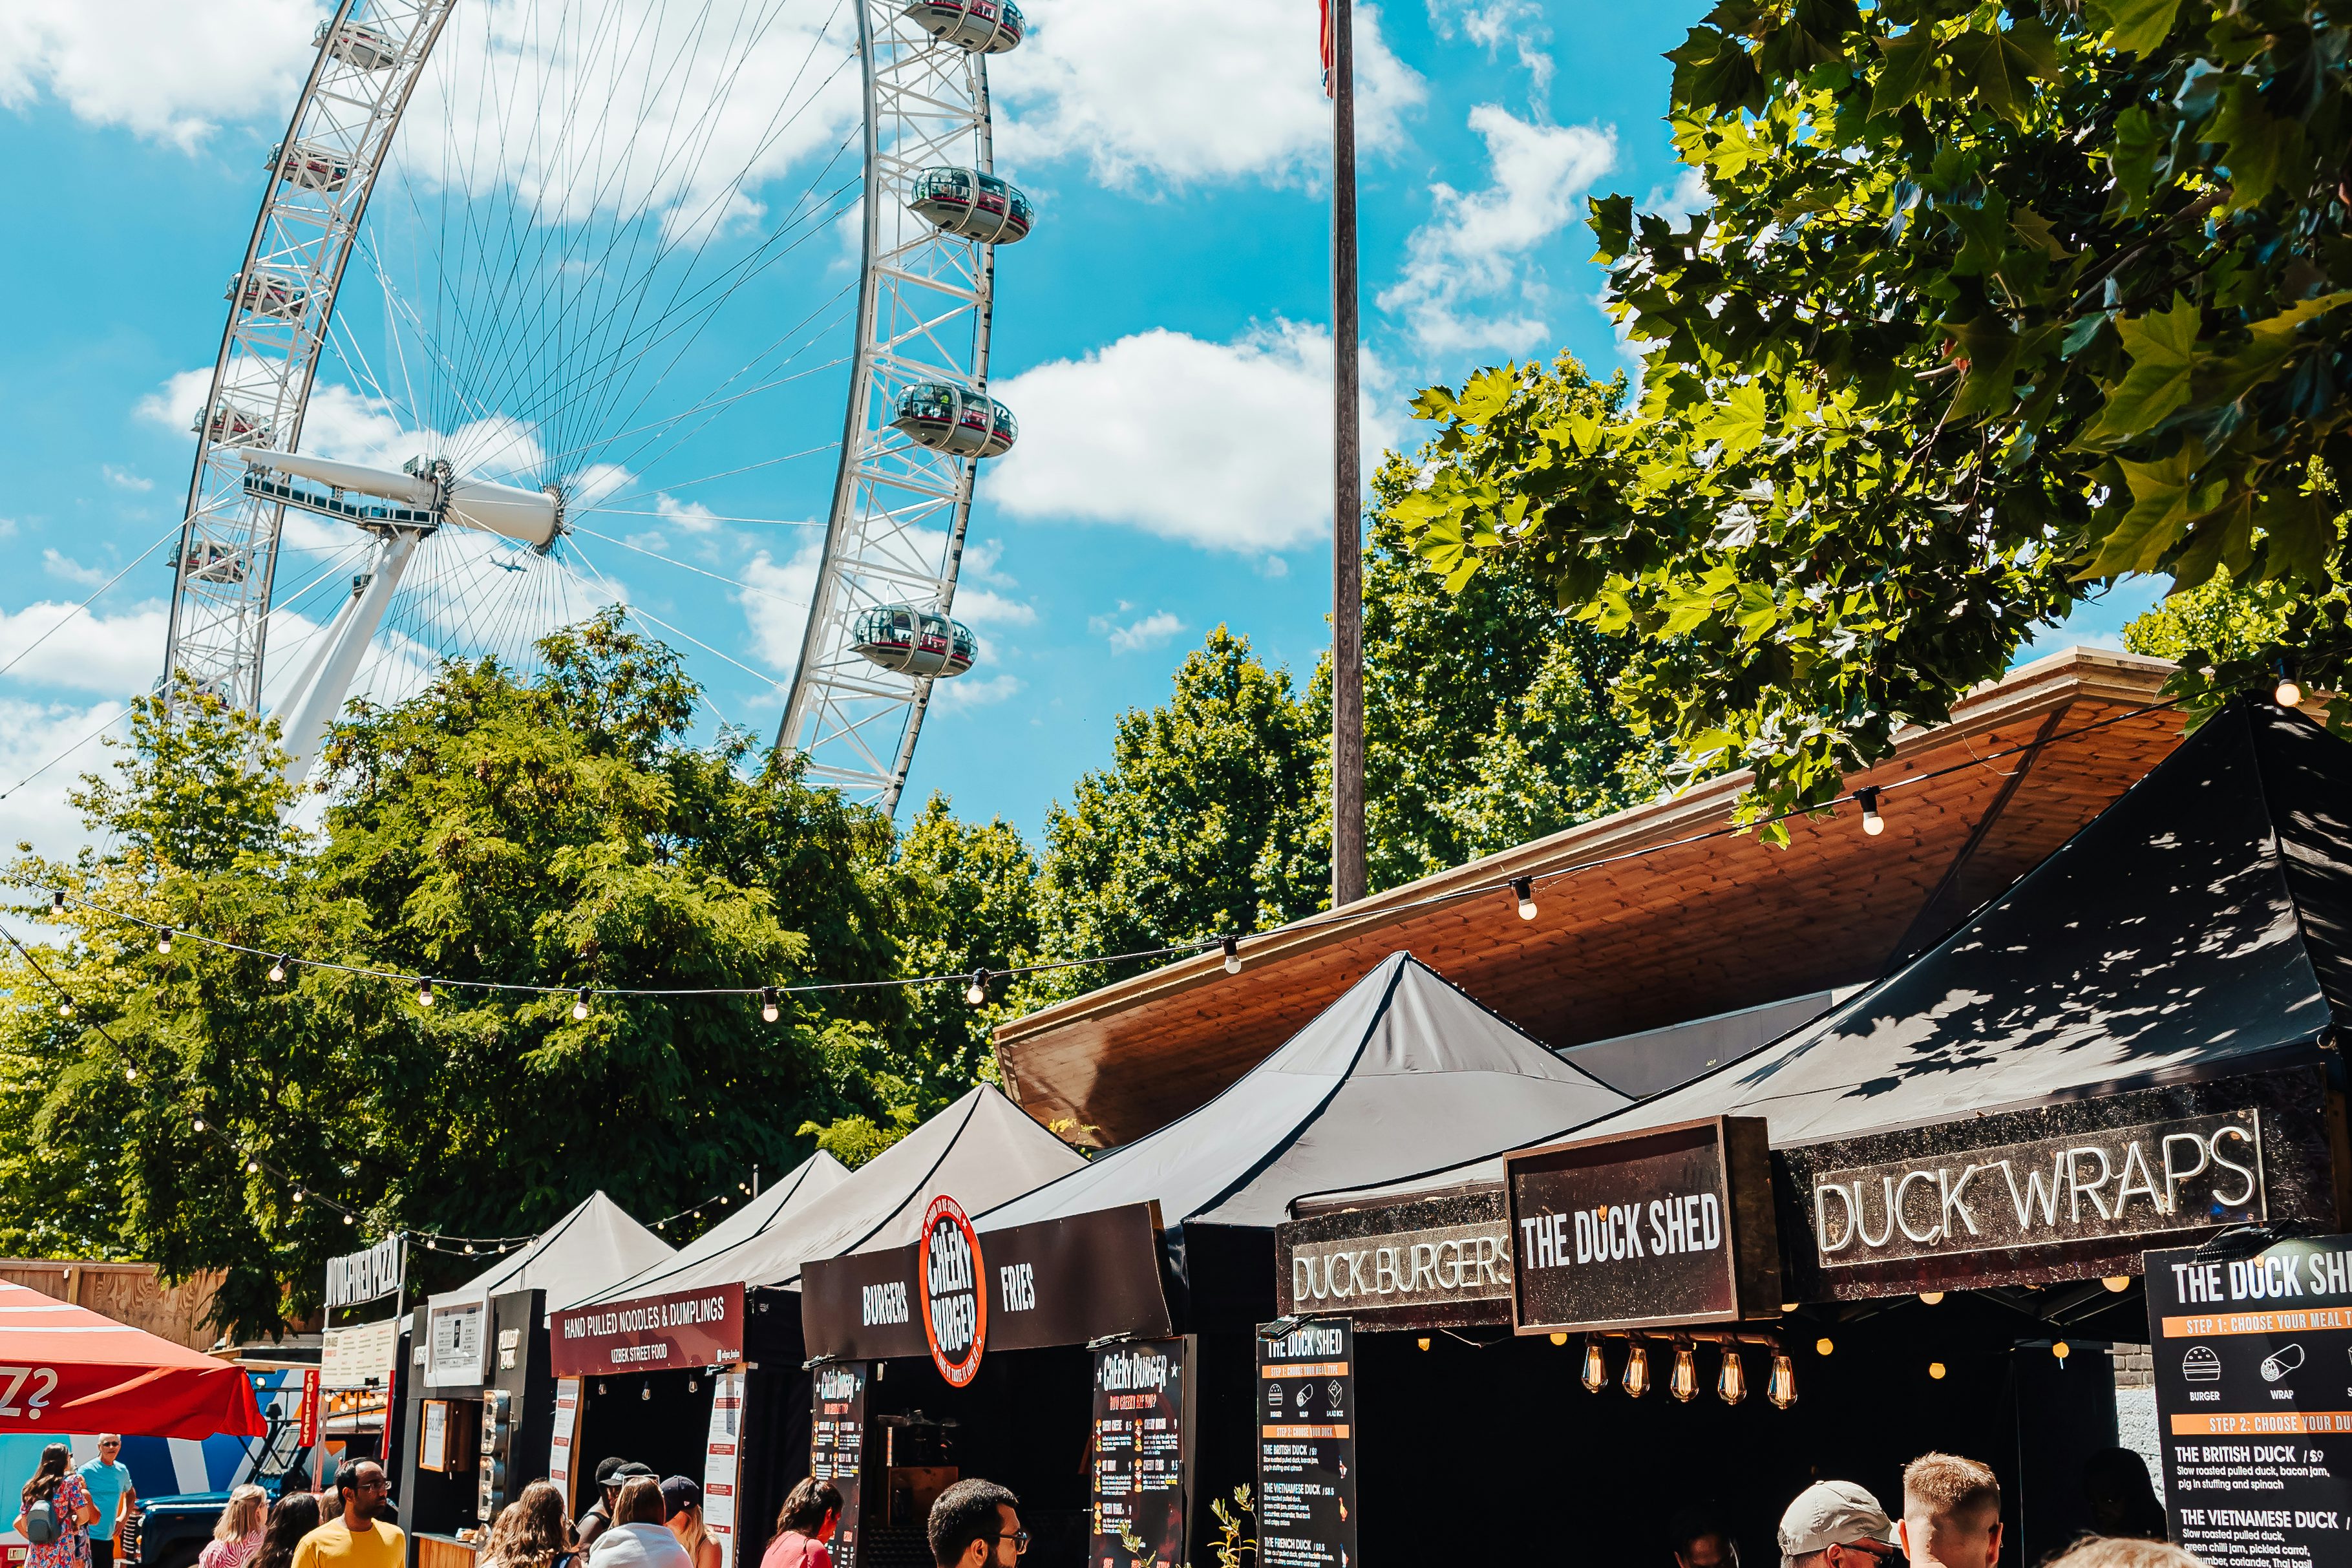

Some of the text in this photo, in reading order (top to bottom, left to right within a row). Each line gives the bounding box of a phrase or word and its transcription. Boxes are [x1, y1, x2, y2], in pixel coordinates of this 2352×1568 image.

[1817, 1126, 2256, 1252] DUCK WRAPS
[936, 1199, 942, 1214] TO
[1521, 1192, 1721, 1269] THE DUCK SHED
[372, 1236, 398, 1299] PIZZA
[927, 1221, 972, 1297] CHEEKY
[1294, 1251, 1370, 1302] DUCK
[2171, 1264, 2223, 1303] THE
[2229, 1254, 2304, 1300] DUCK
[1000, 1262, 1035, 1312] FRIES
[863, 1281, 909, 1326] BURGERS
[564, 1296, 725, 1339] HAND PULLED NOODLES & DUMPLINGS
[931, 1293, 976, 1352] BURGER
[2187, 1311, 2342, 1335] STEP 1: CHOOSE YOUR MEAL
[1287, 1330, 1315, 1357] DUCK
[1316, 1329, 1342, 1356] SHED
[611, 1343, 667, 1364] UZBEK STREET FOOD
[1103, 1350, 1167, 1393] CHEEKY BURGER
[1271, 1367, 1281, 1376] STEP
[1287, 1366, 1304, 1375] CHOOSE
[1327, 1365, 1338, 1375] TYPE
[2190, 1391, 2221, 1401] BURGER
[2270, 1390, 2294, 1399] WRAP
[303, 1372, 314, 1445] COLLECT
[1277, 1427, 1287, 1436] STEP
[1293, 1427, 1309, 1436] CHOOSE
[2209, 1417, 2236, 1432] STEP
[2240, 1416, 2251, 1432] 2:
[2254, 1415, 2298, 1431] CHOOSE
[2301, 1415, 2332, 1431] YOUR
[1263, 1445, 1308, 1456] THE BRITISH DUCK
[2175, 1446, 2199, 1463] THE
[2202, 1446, 2251, 1463] BRITISH
[2254, 1445, 2296, 1463] DUCK
[2177, 1466, 2330, 1478] Slow roasted pulled duck, bacon jam,
[1264, 1482, 1320, 1495] THE VIETNAMESE DUCK
[2178, 1479, 2284, 1491] pig in stuffing and spinach
[2181, 1509, 2205, 1525] THE
[2207, 1509, 2291, 1527] VIETNAMESE
[2295, 1512, 2338, 1529] DUCK
[1264, 1537, 1311, 1551] THE FRENCH DUCK
[2183, 1529, 2285, 1542] Slow roasted pulled duck,
[2184, 1543, 2311, 1556] green chilli jam, pickled carrot,
[2230, 1557, 2313, 1568] coriander, Thai basil
